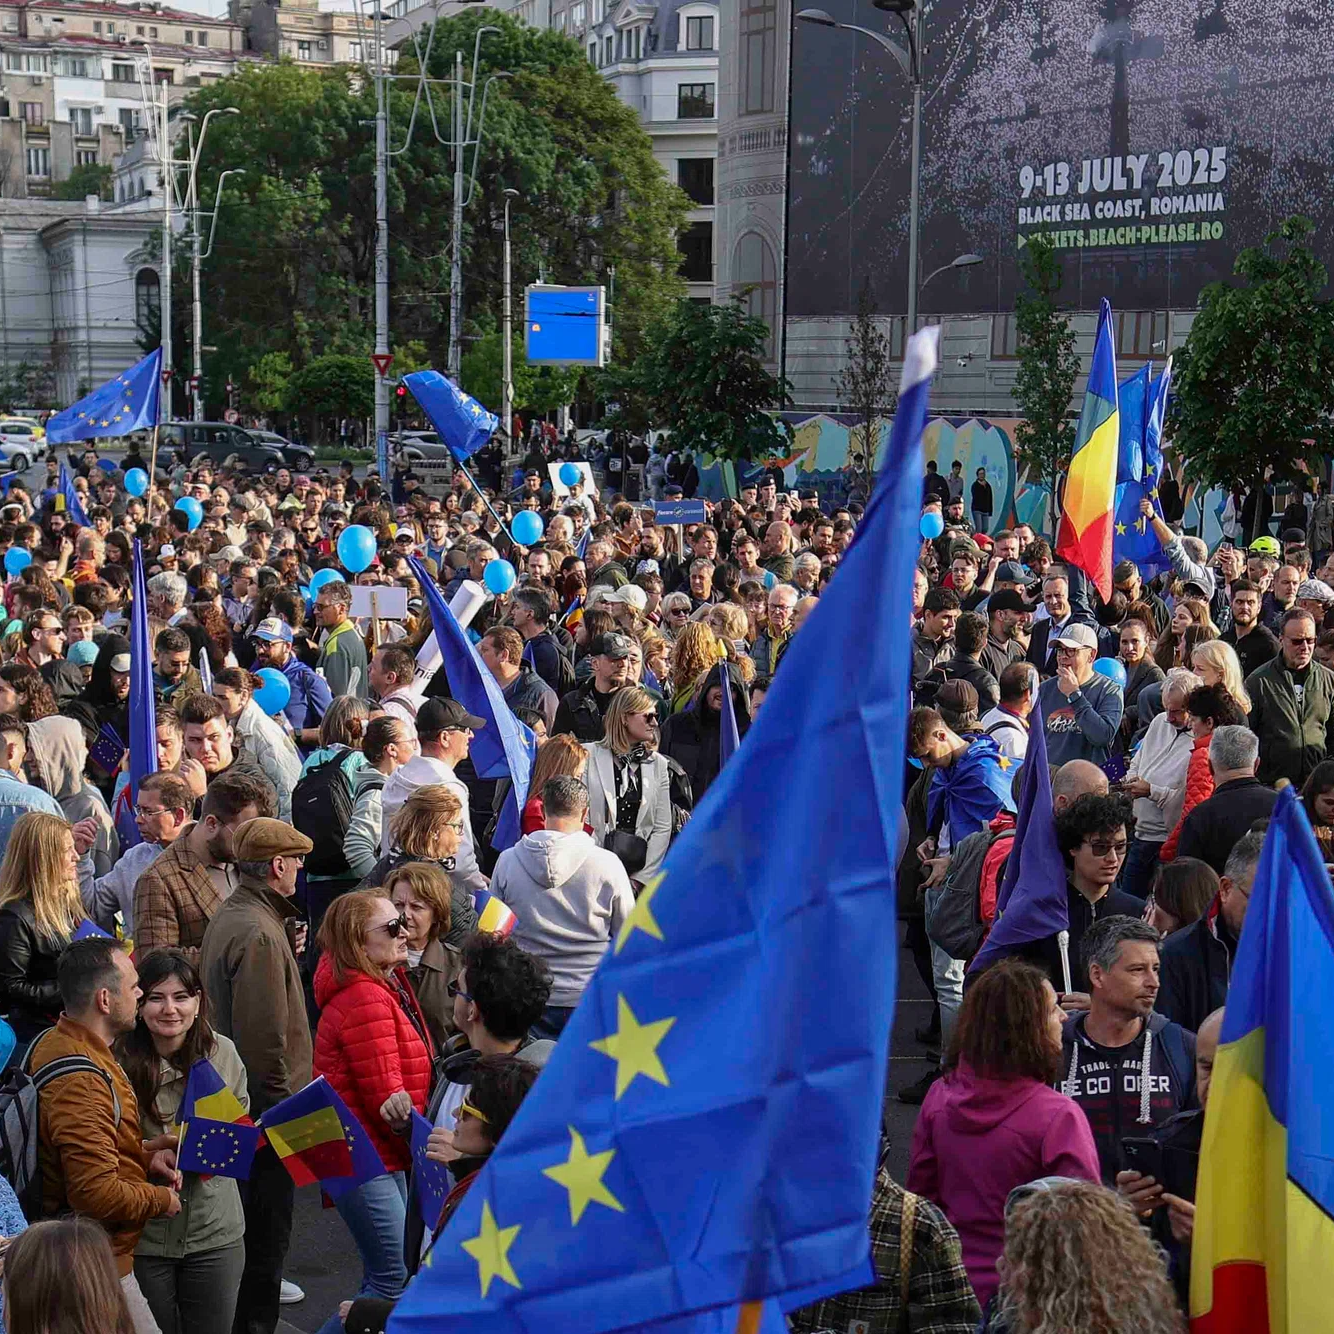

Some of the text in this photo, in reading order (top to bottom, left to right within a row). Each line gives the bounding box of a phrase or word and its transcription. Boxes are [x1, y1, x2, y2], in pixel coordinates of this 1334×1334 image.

[1019, 146, 1227, 199] 9-13 JULY 2025
[1018, 192, 1226, 225] BLACK SEA COAST, ROMANIA
[1028, 220, 1224, 249] KETS.BEACH-PLEASE.RO
